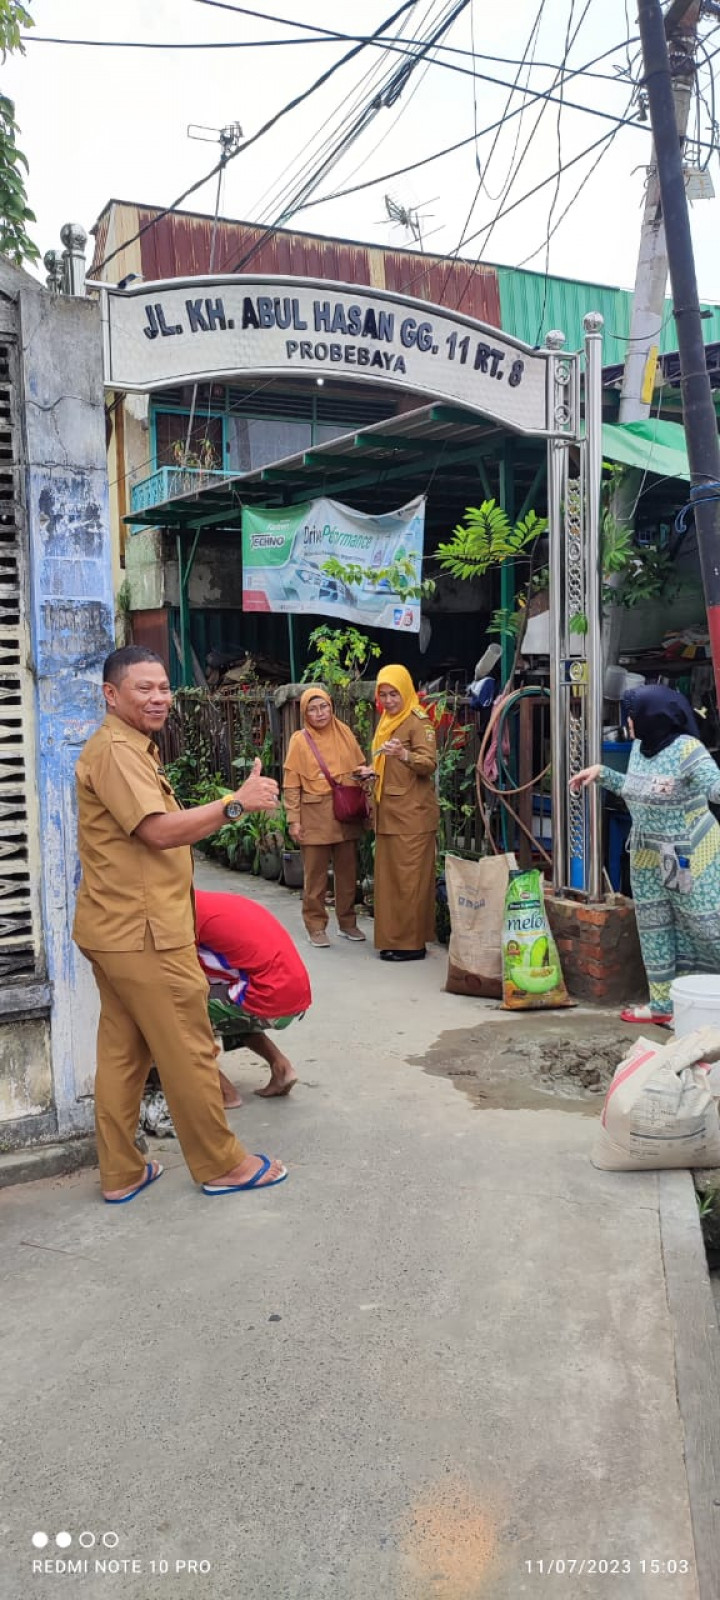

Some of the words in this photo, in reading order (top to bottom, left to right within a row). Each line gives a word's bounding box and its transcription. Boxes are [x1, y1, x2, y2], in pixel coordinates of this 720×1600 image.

[144, 303, 184, 340] JL.
[185, 298, 235, 333] KH.
[241, 296, 308, 330] ABUL
[314, 301, 394, 342] HASAN
[400, 317, 439, 354] GG.
[445, 332, 470, 364] 11
[473, 342, 505, 380] RT.
[508, 359, 525, 387] 8
[285, 339, 407, 374] PROBEBAYA
